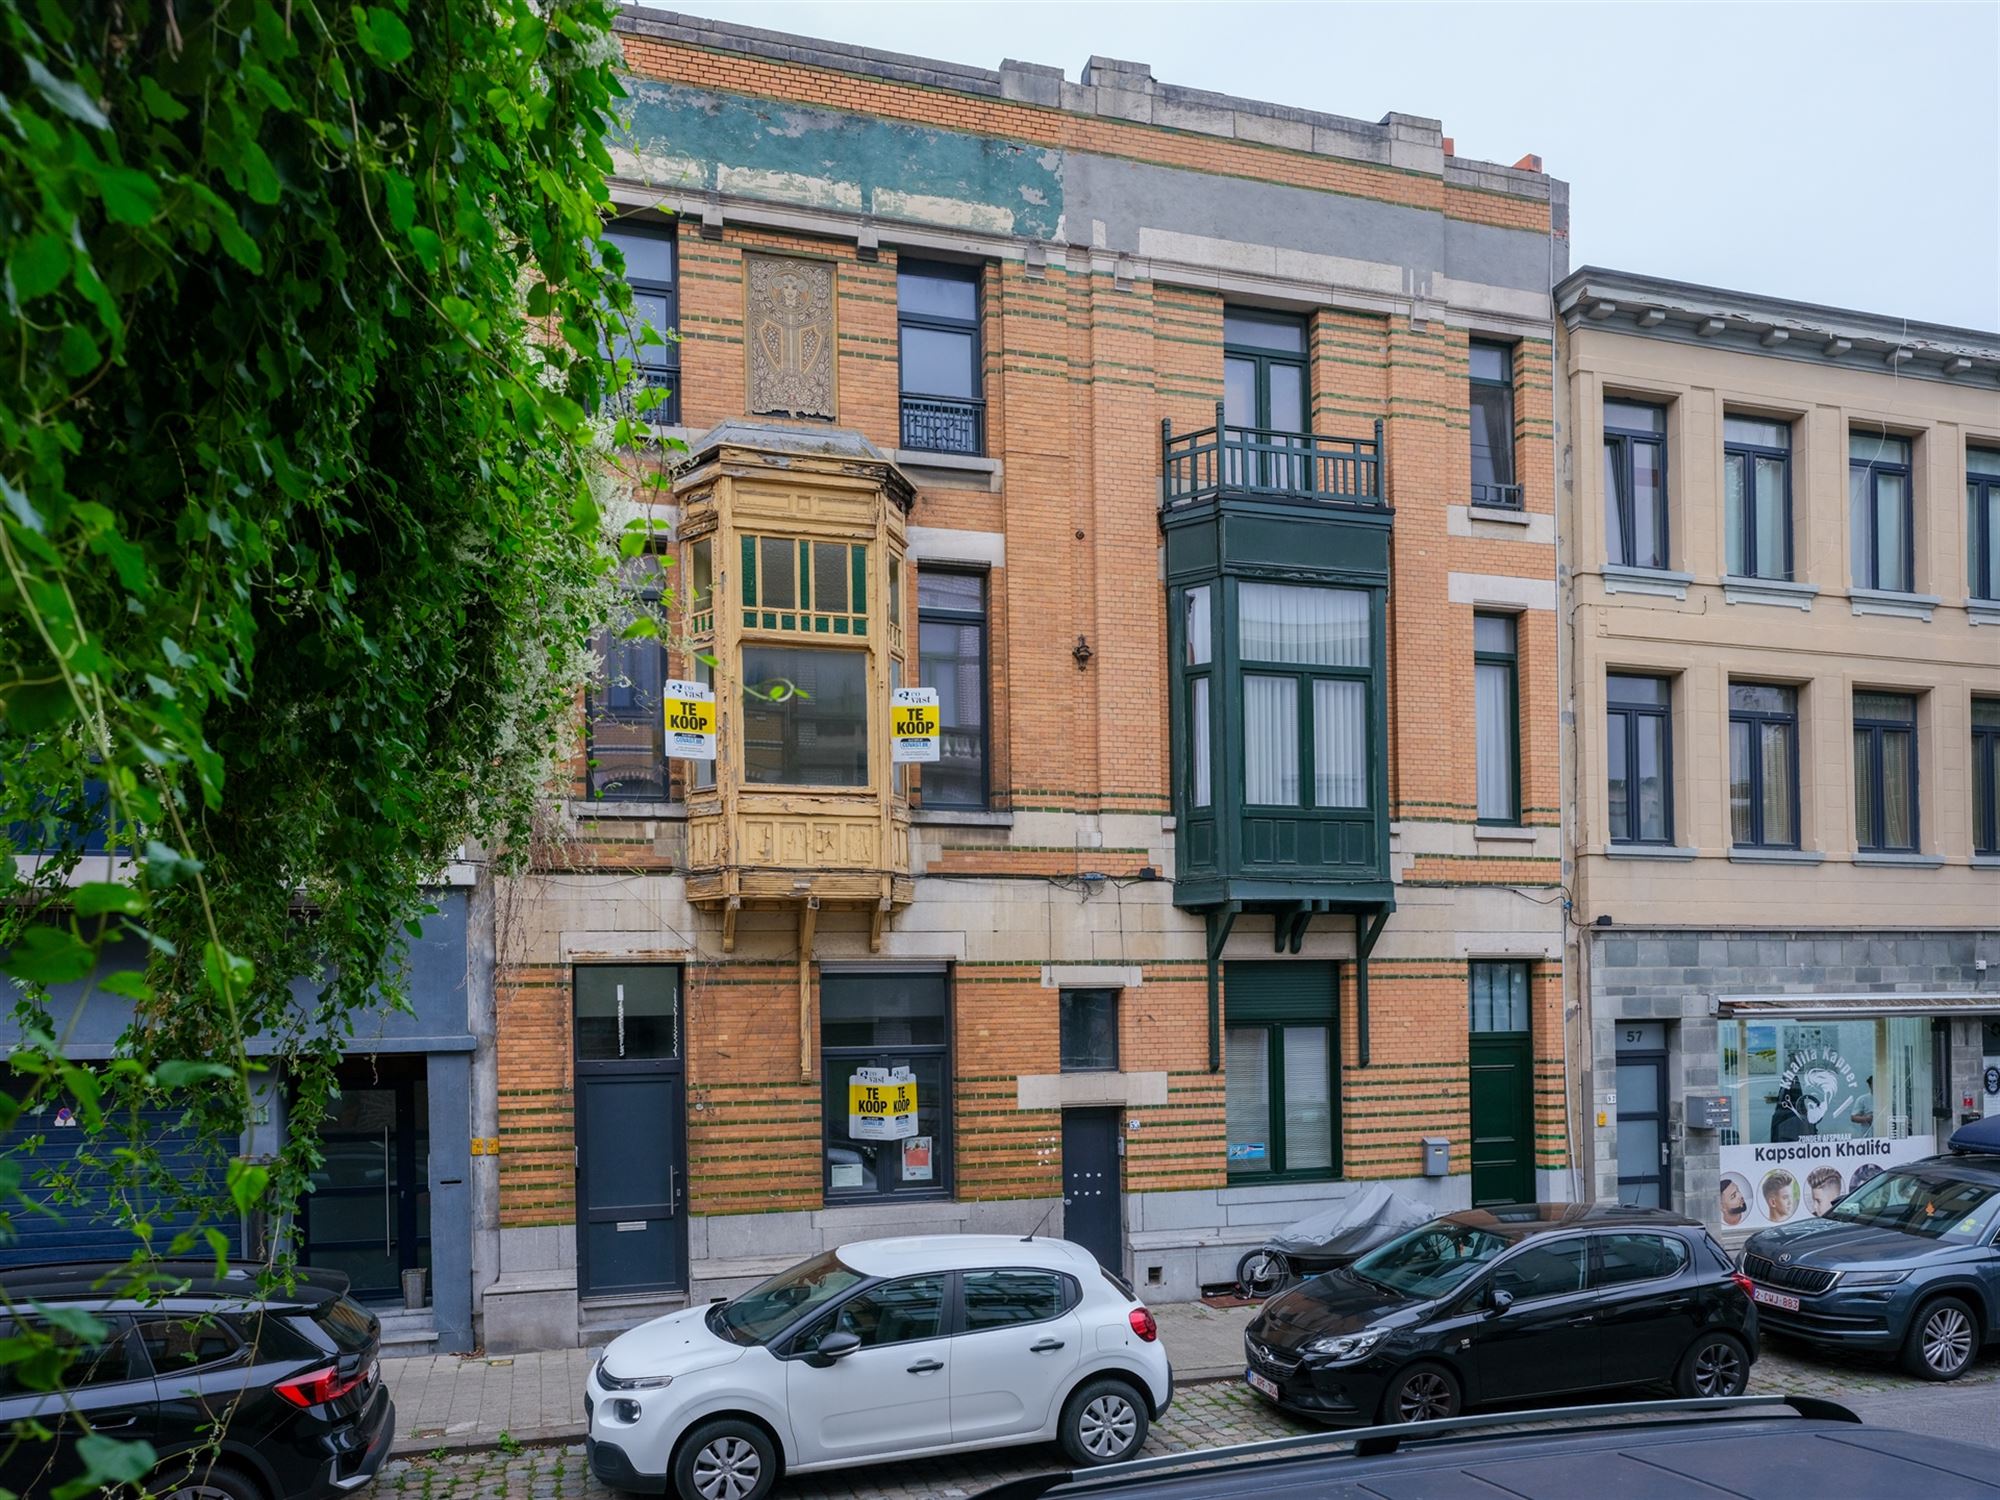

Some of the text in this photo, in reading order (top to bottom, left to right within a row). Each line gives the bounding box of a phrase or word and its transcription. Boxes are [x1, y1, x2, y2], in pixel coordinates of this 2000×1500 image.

[684, 691, 704, 699] vast
[911, 696, 931, 704] vast
[680, 702, 697, 716] TE
[907, 708, 924, 721] TE
[670, 714, 708, 731] KOOP
[896, 721, 935, 735] KOOP
[1626, 1030, 1643, 1043] 57
[1780, 1046, 1858, 1090] Khalifa Kapper
[866, 1087, 879, 1100] TE
[897, 1086, 906, 1098] TE
[858, 1099, 888, 1114] KOOP
[893, 1098, 911, 1113] KOOP
[1755, 1139, 1891, 1163] Kapsalon Khalifa
